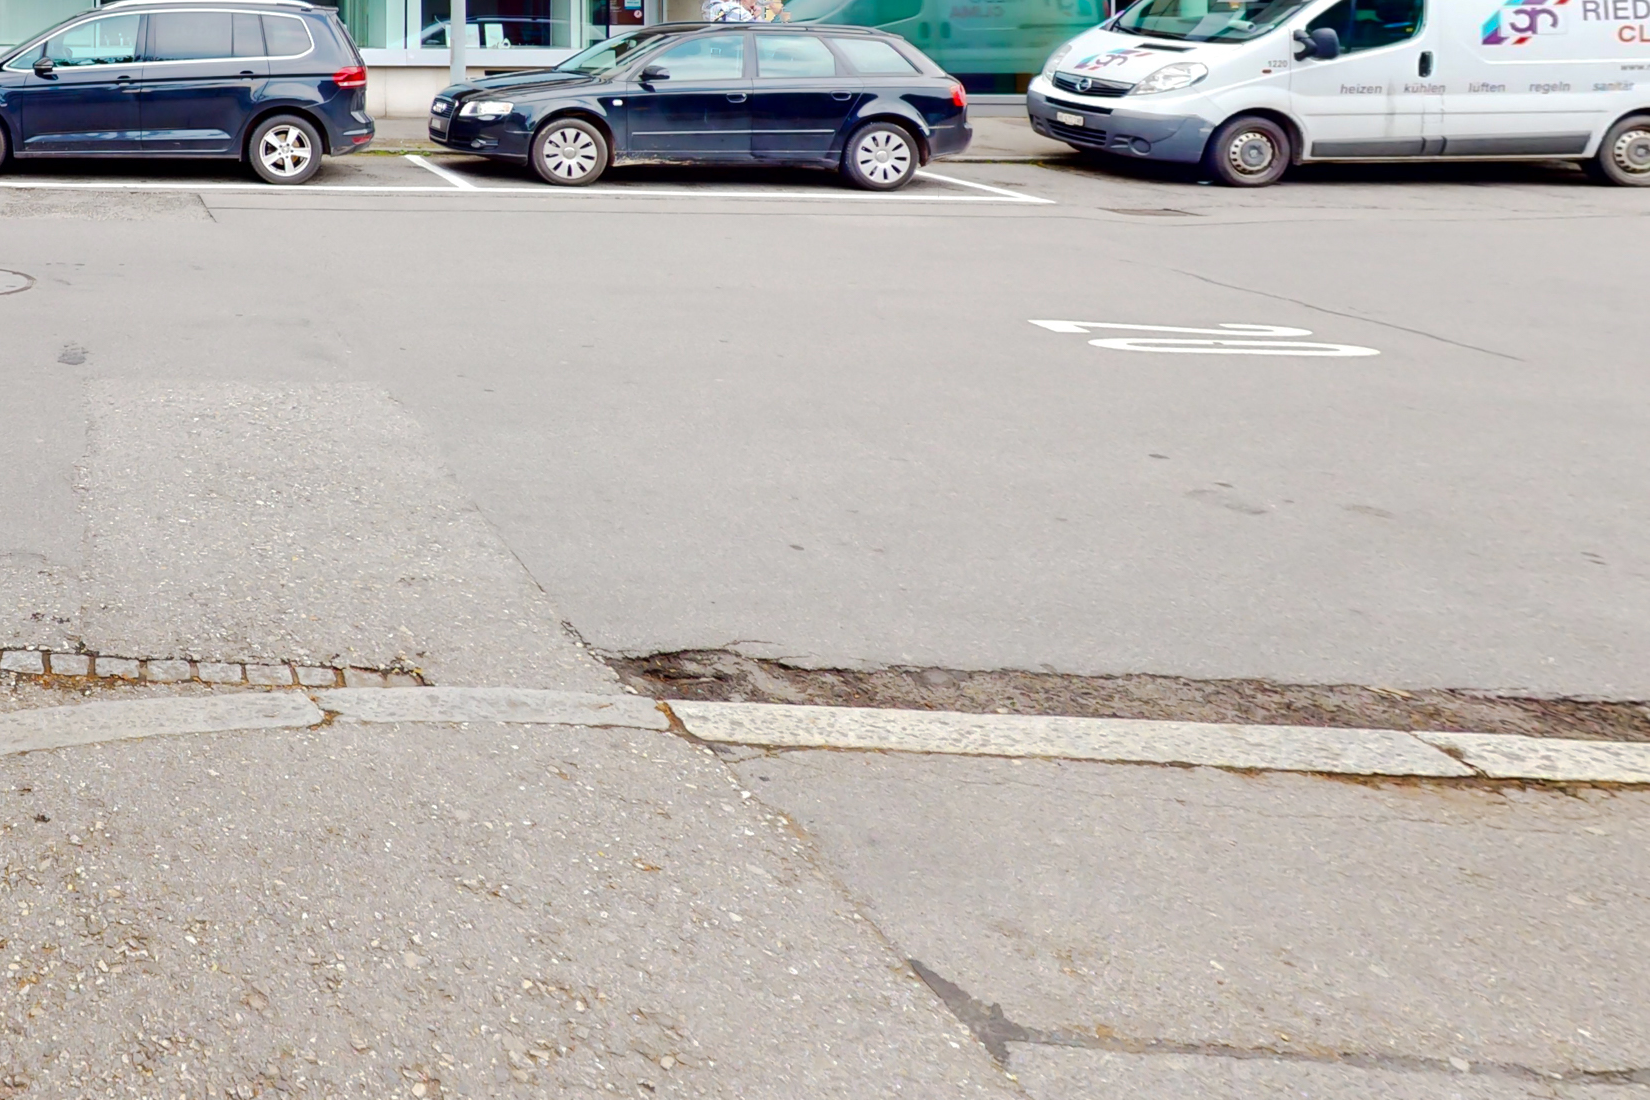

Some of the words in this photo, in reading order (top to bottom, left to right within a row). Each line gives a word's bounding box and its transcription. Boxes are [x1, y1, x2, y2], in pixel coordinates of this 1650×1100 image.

[1267, 59, 1288, 68] 1220
[1340, 83, 1383, 94] heizen
[1404, 82, 1446, 94] kühlen
[1468, 82, 1506, 94] lüften
[1529, 81, 1571, 95] regeln
[1592, 80, 1635, 92] sanitär
